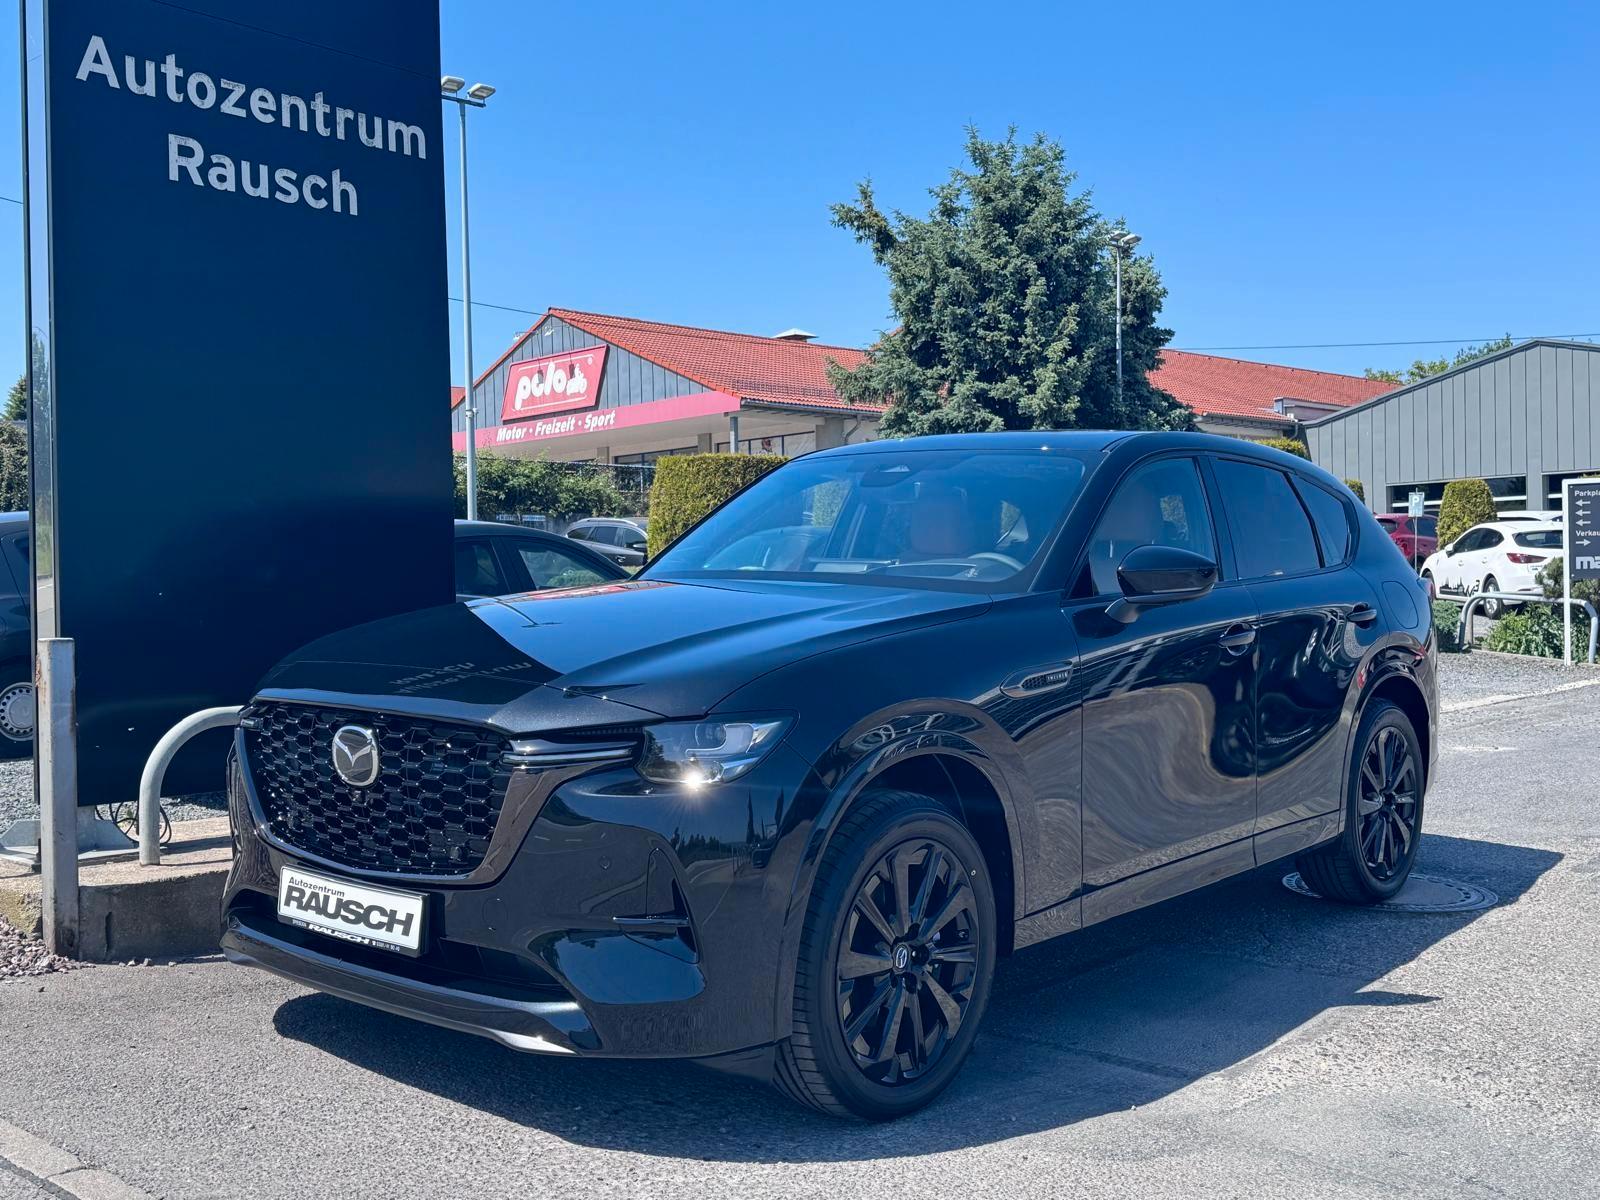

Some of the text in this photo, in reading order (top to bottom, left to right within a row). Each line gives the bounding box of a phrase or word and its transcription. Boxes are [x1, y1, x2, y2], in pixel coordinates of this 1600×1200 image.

[75, 34, 427, 160] Autozentrum
[168, 133, 359, 216] Rausch
[497, 410, 615, 441] Motor Freizeit Sport
[1412, 496, 1420, 507] P
[1574, 489, 1600, 498] Parkpl
[288, 876, 345, 898] Autozentrum
[284, 885, 414, 936] RAUSCH
[308, 923, 370, 944] RAUSCH
